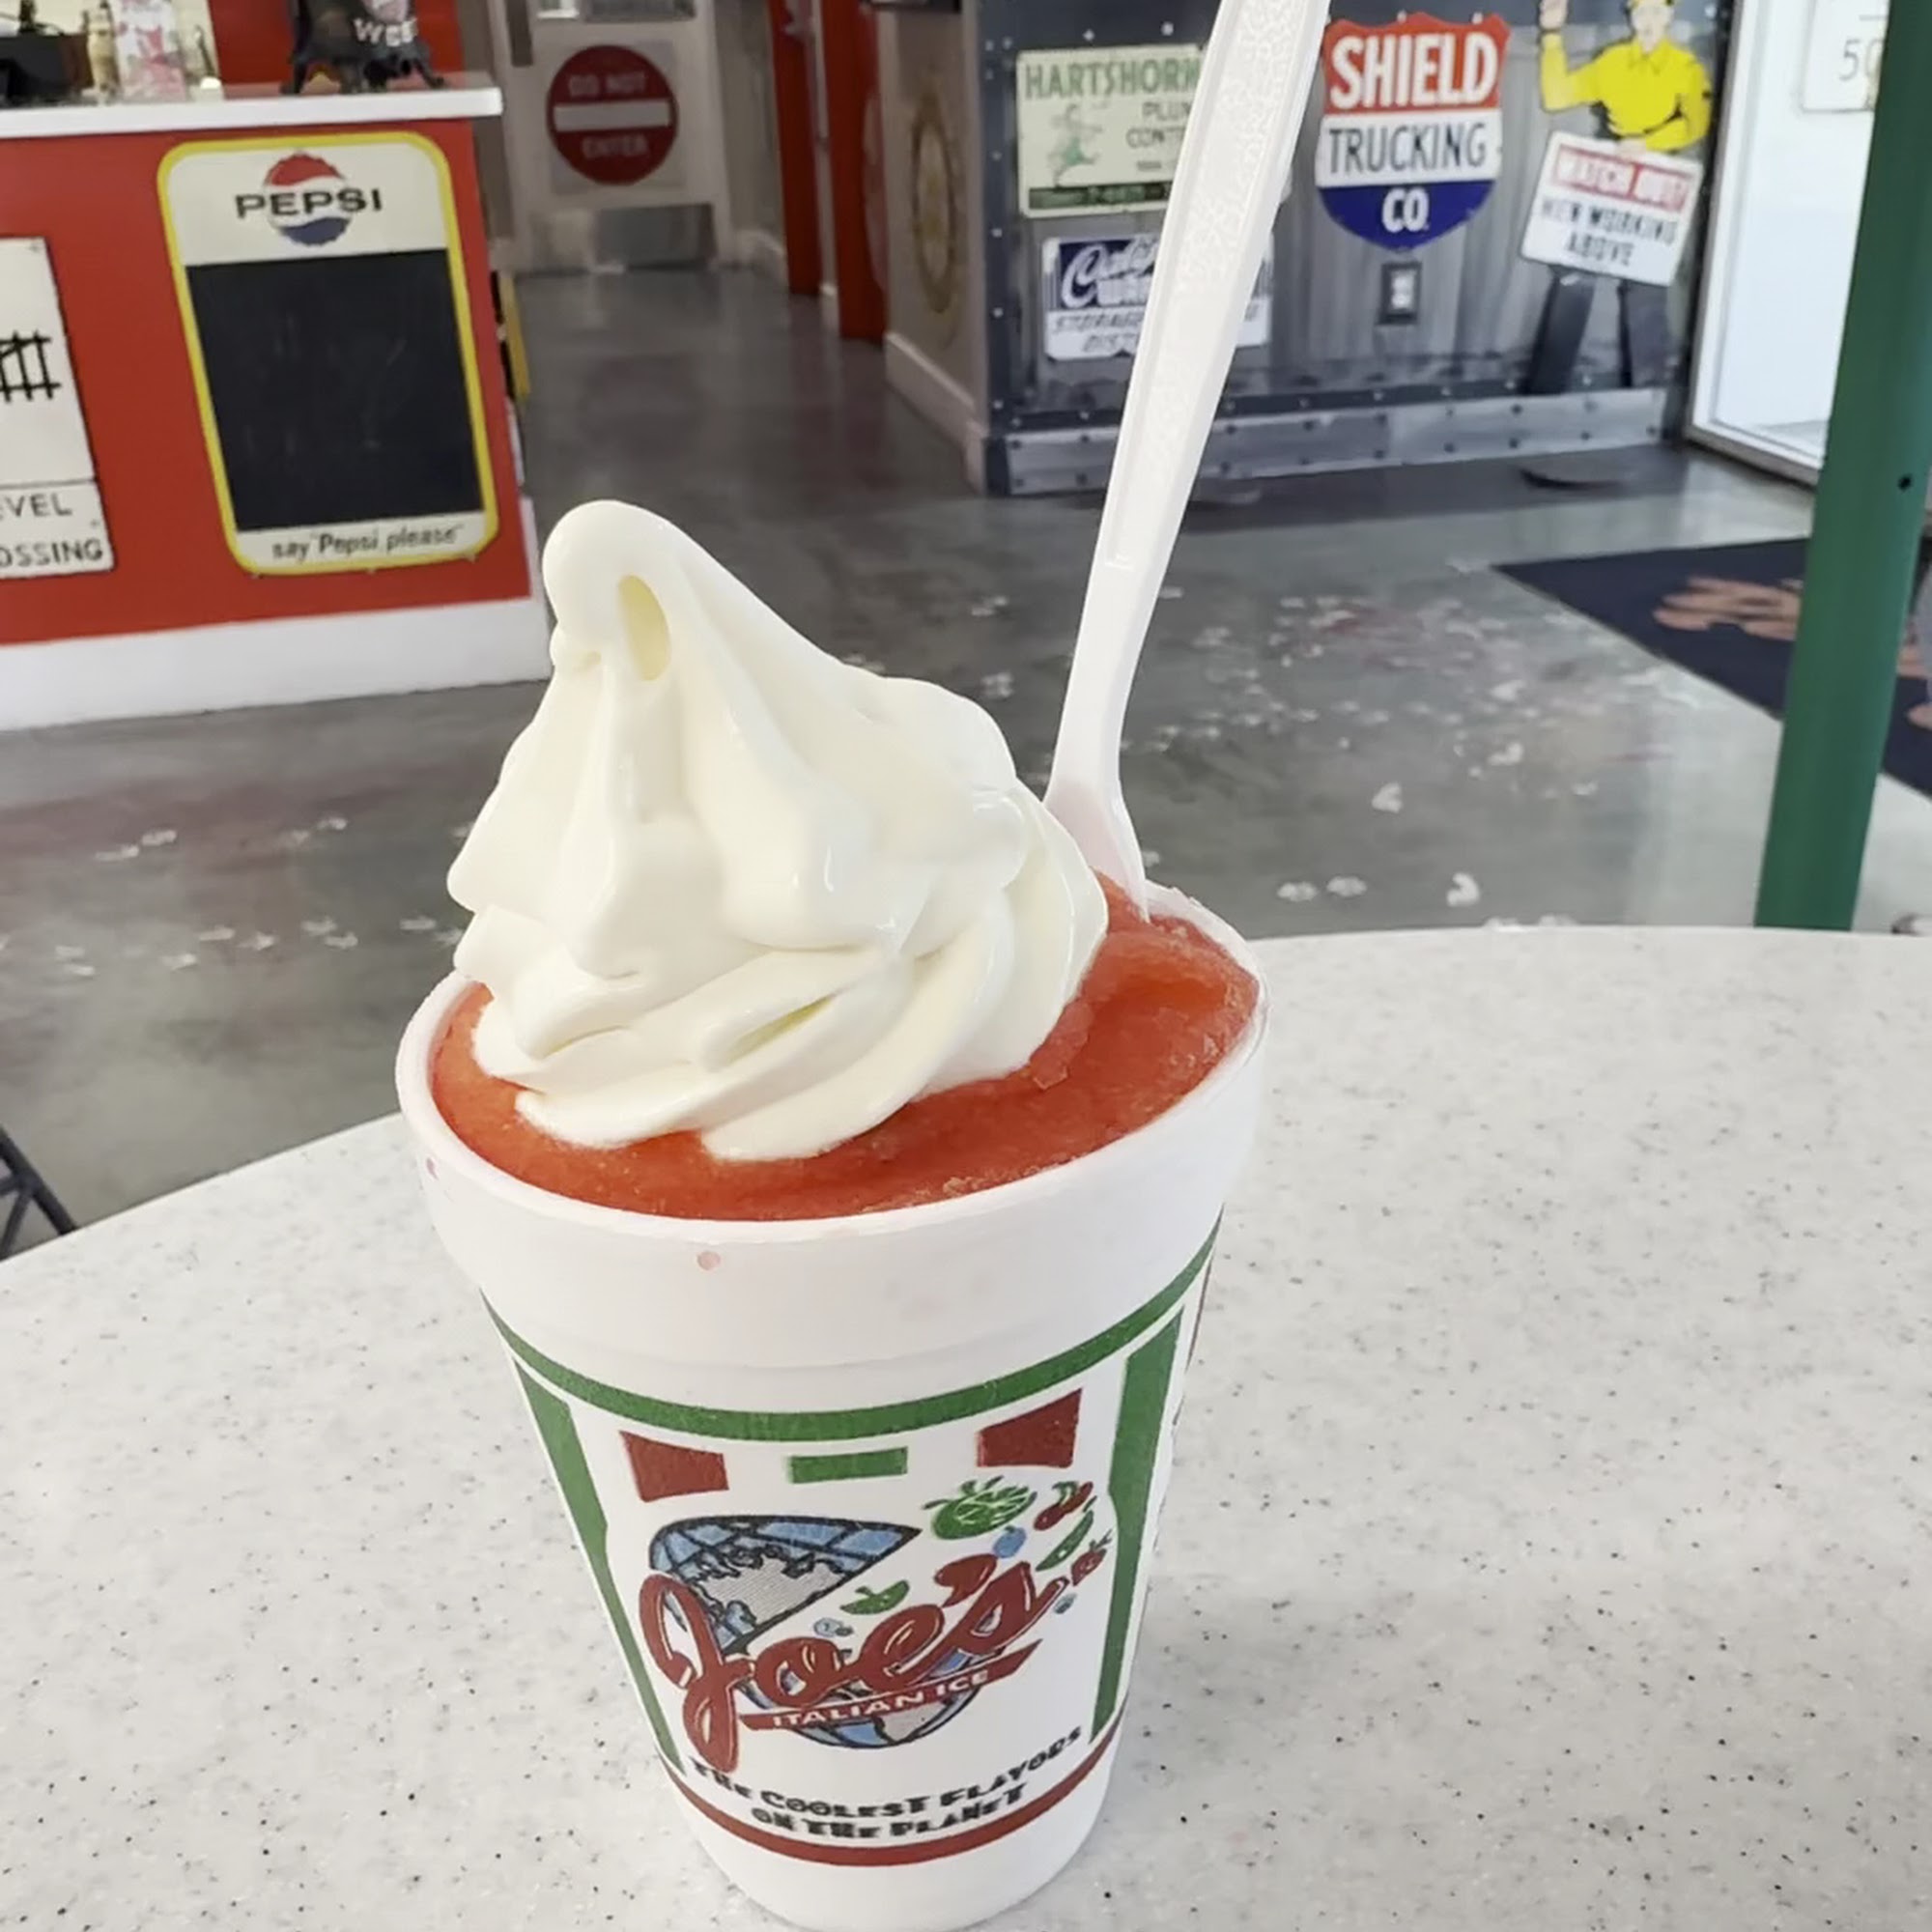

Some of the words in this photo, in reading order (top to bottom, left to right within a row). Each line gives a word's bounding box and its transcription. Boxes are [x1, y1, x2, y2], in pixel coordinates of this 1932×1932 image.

[1329, 31, 1497, 109] SHIELD
[1328, 122, 1486, 175] TRUCKING
[236, 187, 382, 219] PEPSI
[272, 542, 310, 561] say
[639, 1553, 1069, 1775] Joe's
[773, 1690, 924, 1727] ITALIAN
[935, 1669, 989, 1696] ICE
[752, 1807, 796, 1832] ON
